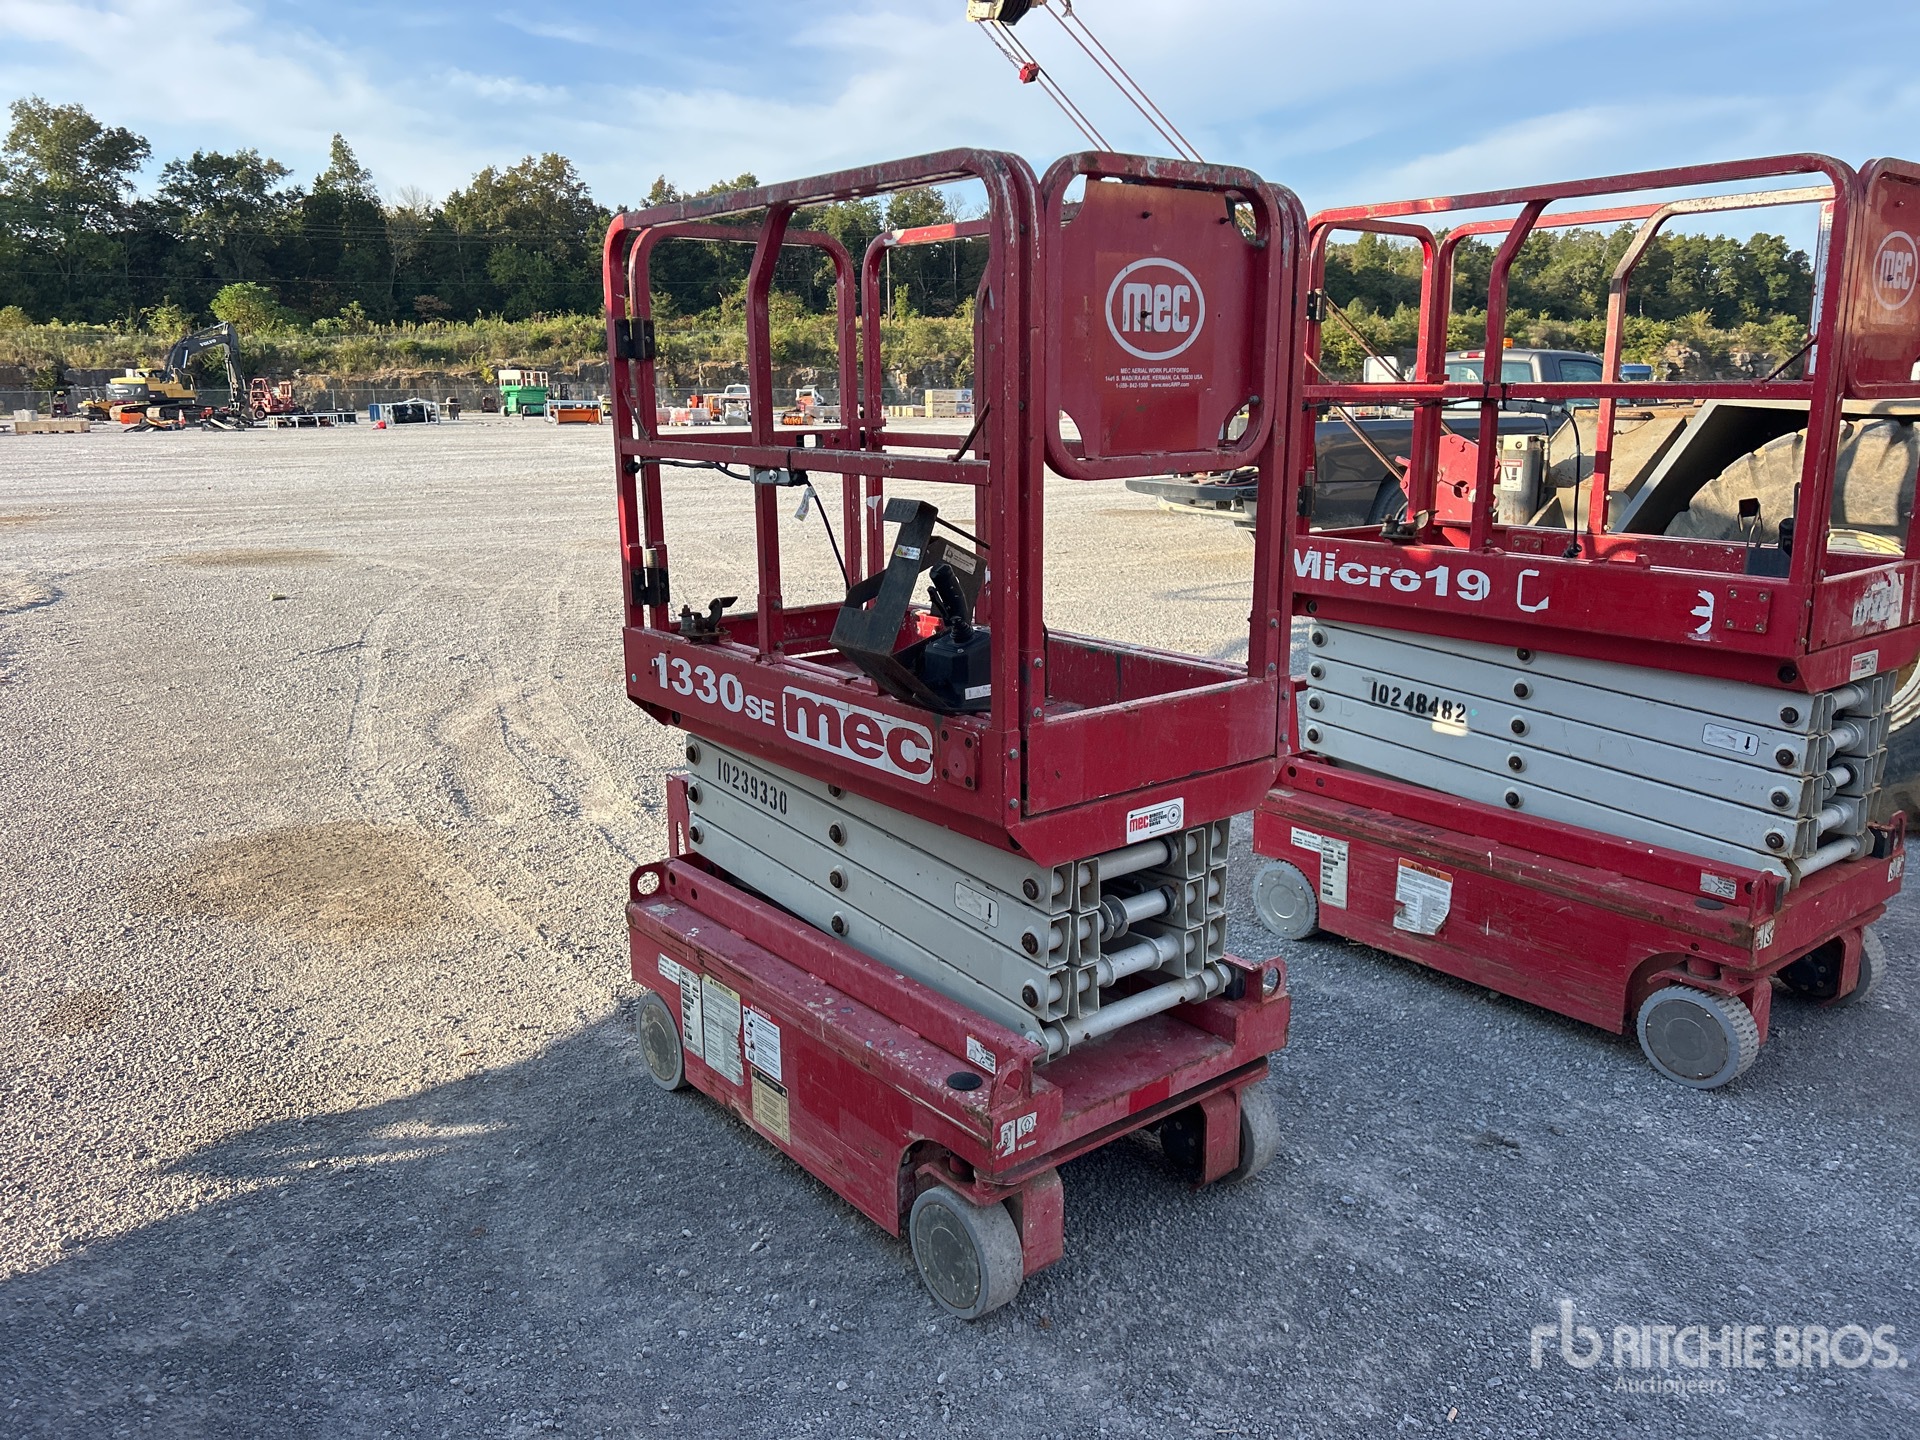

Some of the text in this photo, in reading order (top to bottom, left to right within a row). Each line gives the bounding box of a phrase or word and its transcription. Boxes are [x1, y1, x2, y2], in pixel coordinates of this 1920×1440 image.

[1123, 283, 1190, 332] mec
[1369, 680, 1467, 724] 10248482
[783, 687, 932, 777] mec
[718, 757, 788, 815] 10239330
[1415, 863, 1441, 878] WARNING
